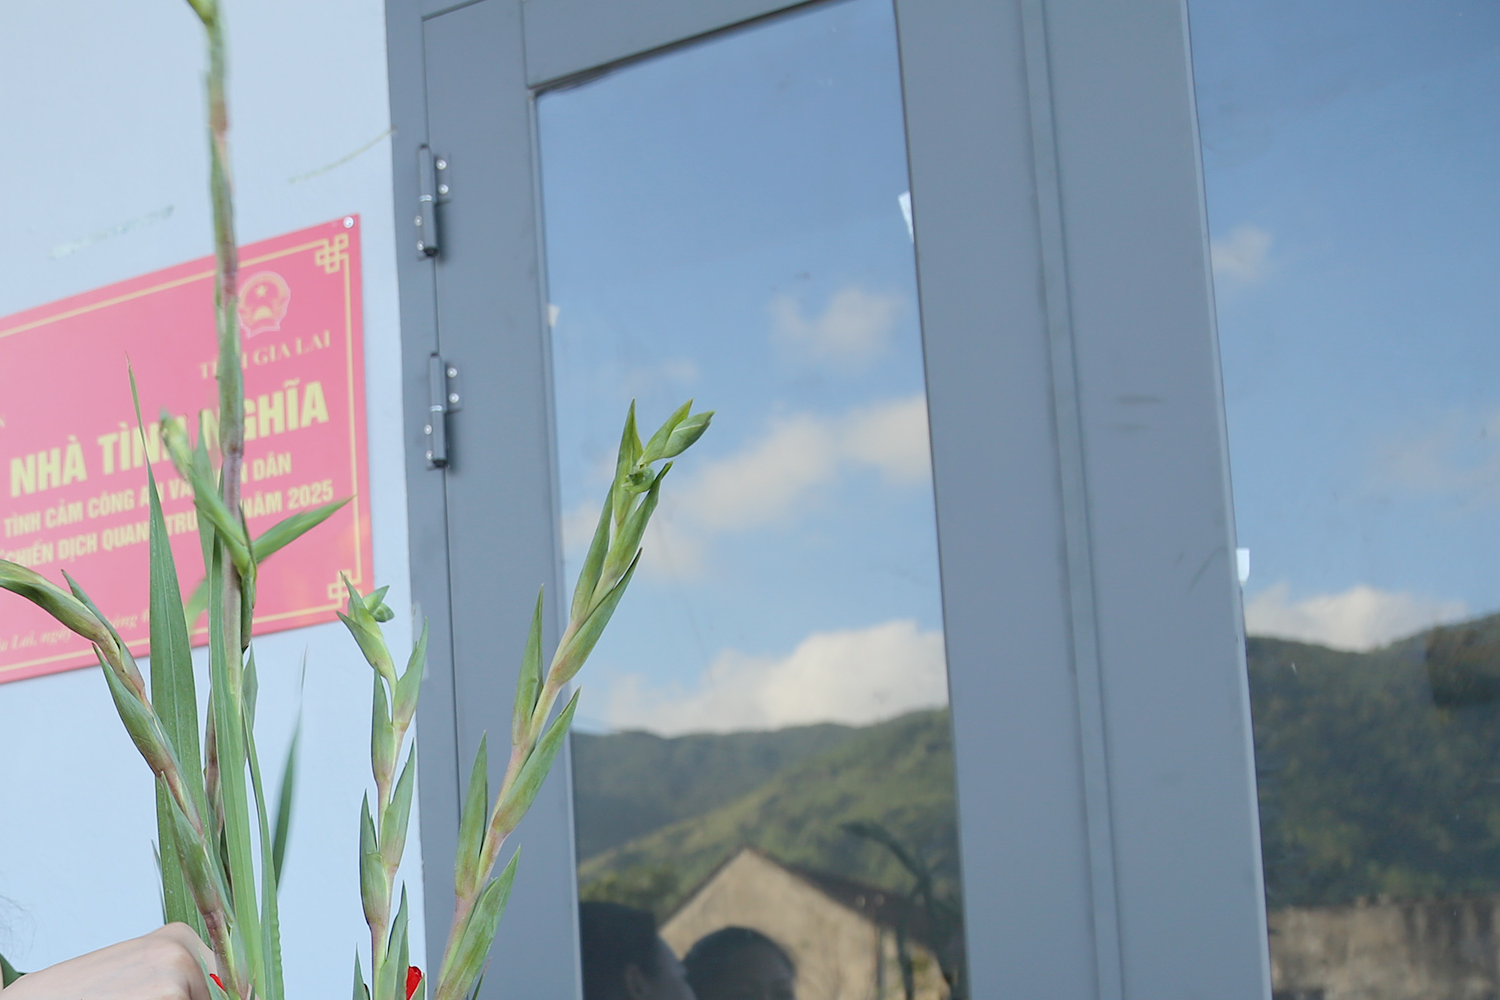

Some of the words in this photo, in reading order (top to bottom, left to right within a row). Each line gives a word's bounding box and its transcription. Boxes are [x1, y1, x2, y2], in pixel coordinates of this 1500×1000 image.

[252, 342, 291, 366] GIA
[295, 329, 331, 355] LAI
[3, 511, 42, 539] TÌNH
[44, 498, 84, 529] CẢM
[87, 489, 135, 519] CÔNG
[252, 451, 292, 482] DÂN
[10, 434, 88, 498] NHÀ
[57, 531, 98, 563] DỊCH
[102, 520, 150, 552] QUAN
[286, 478, 335, 511] 2025
